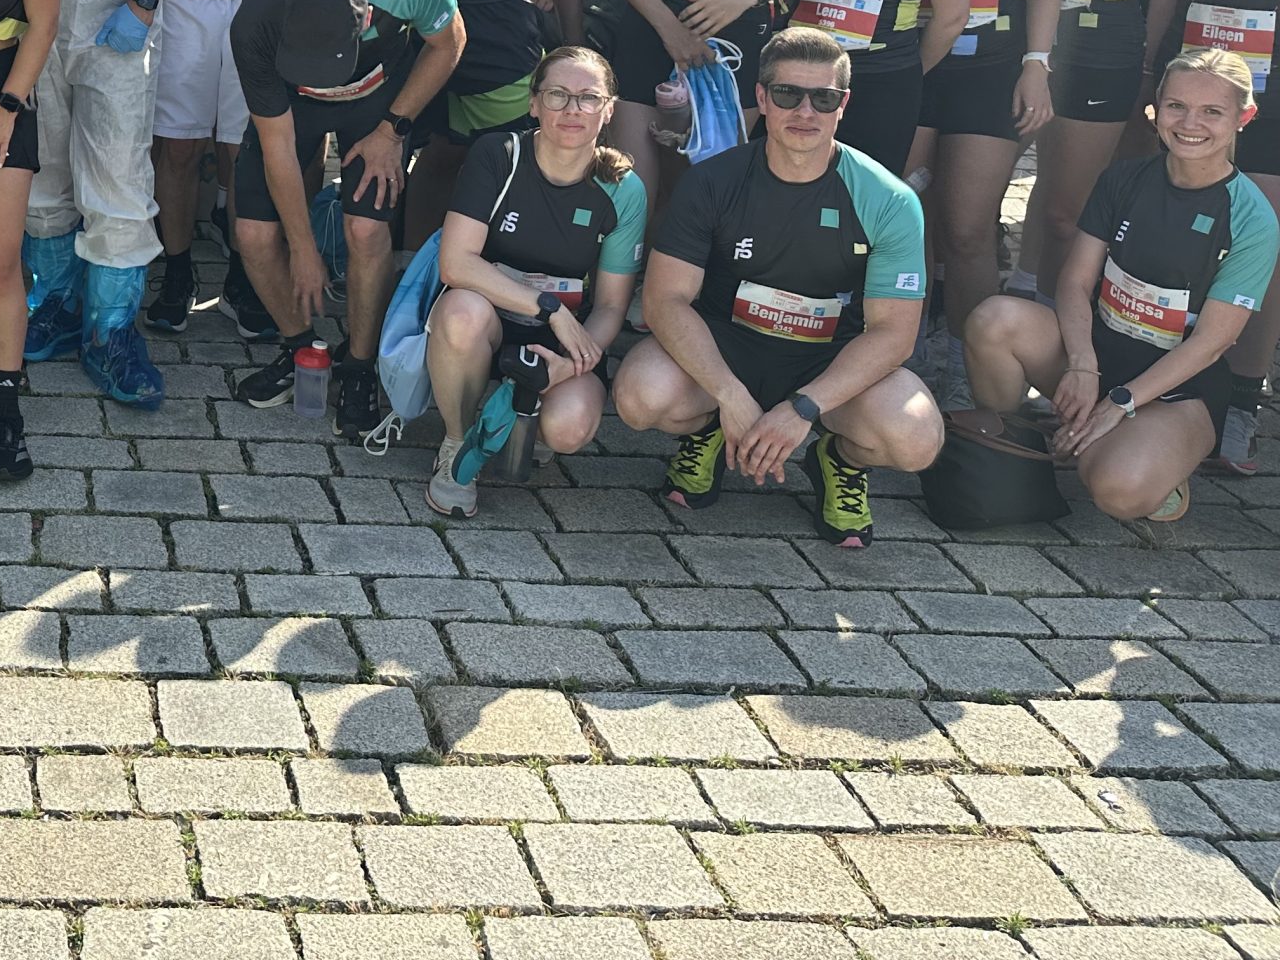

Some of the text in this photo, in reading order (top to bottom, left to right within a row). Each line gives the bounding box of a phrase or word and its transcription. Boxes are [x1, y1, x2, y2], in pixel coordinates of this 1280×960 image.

[815, 3, 847, 21] Lena
[1201, 24, 1245, 43] Eileen
[1109, 284, 1164, 320] Clarissa
[747, 302, 824, 330] Benjamin
[1120, 308, 1140, 321] 5420
